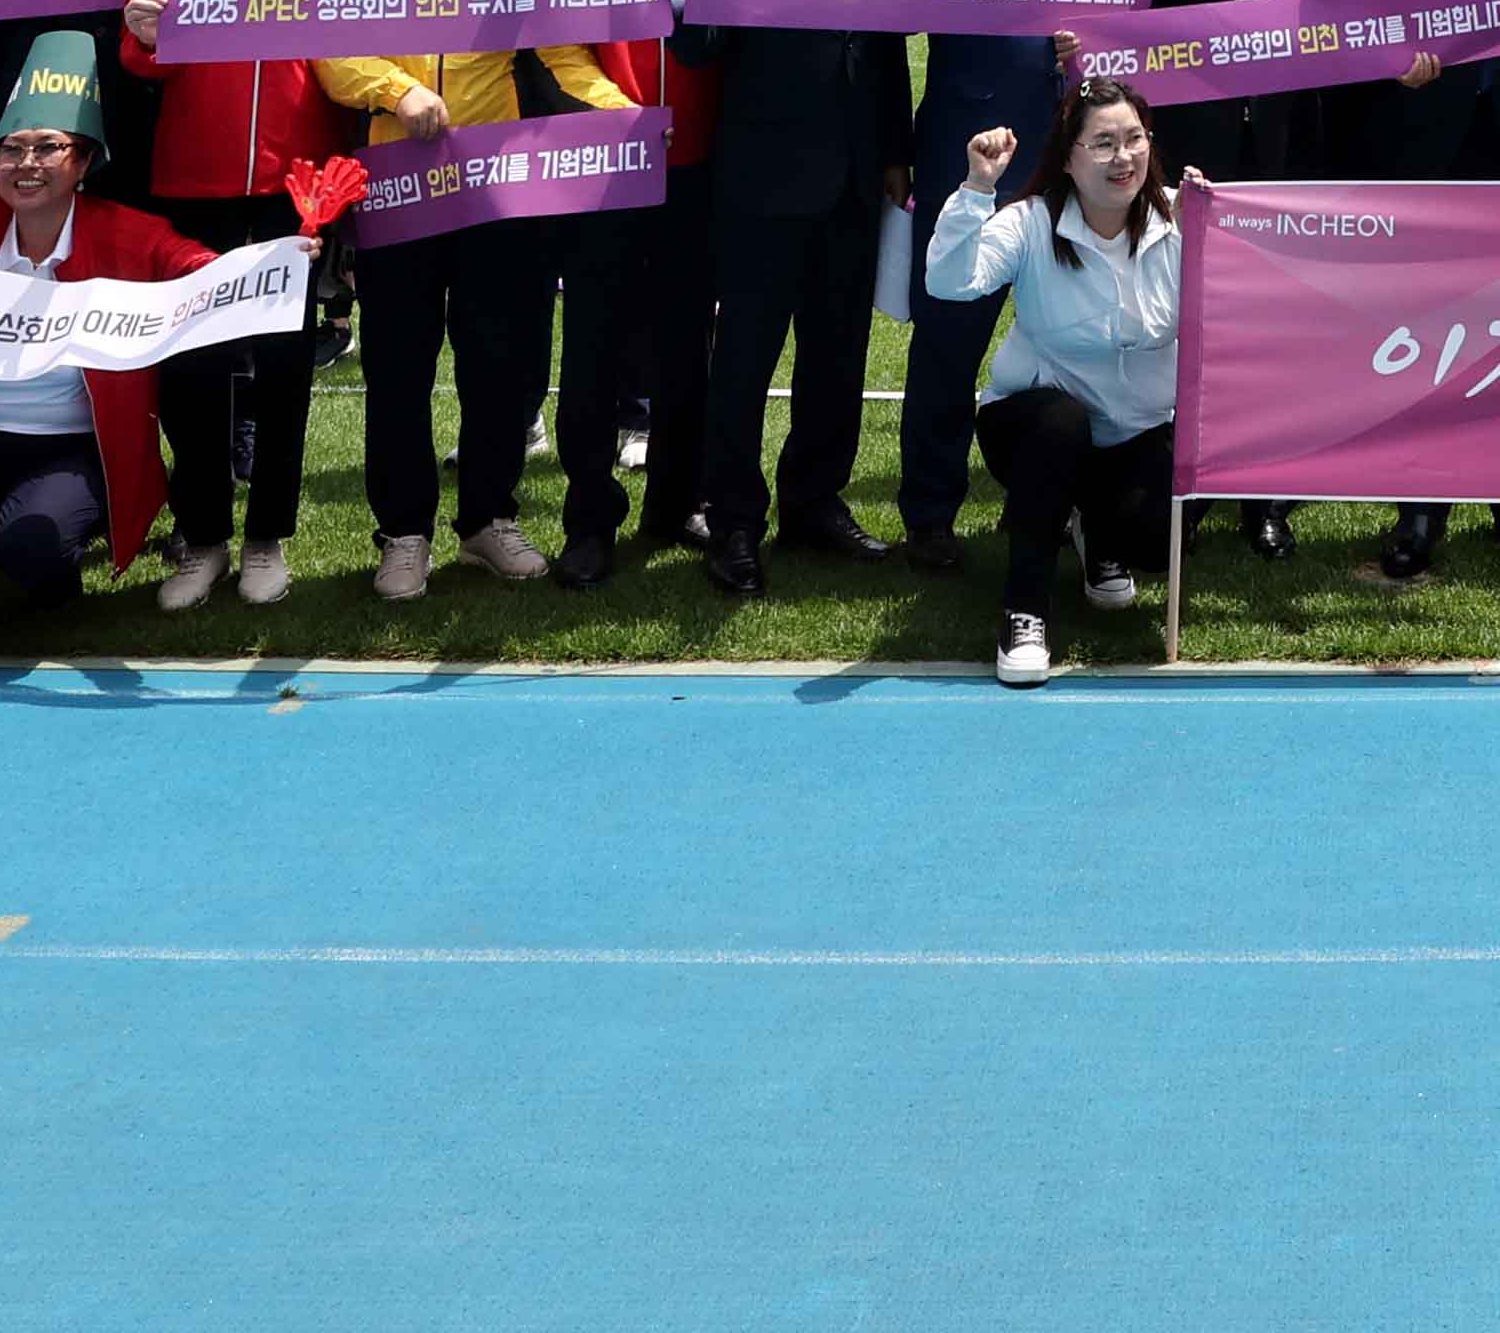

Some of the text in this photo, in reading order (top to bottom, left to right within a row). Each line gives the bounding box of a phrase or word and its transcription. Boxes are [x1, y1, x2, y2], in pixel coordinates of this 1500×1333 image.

[1082, 48, 1138, 78] 2025
[1144, 42, 1203, 72] APEC
[1210, 30, 1292, 65] 정상회의
[1297, 23, 1339, 55] 인천
[1344, 14, 1406, 47] 유치를
[30, 66, 91, 99] Now,
[427, 141, 652, 198] 인천 유치를 기원합니다.
[1218, 212, 1395, 237] all ways INCHEON
[83, 309, 165, 338] 이제는
[171, 266, 292, 328] 인천입니다
